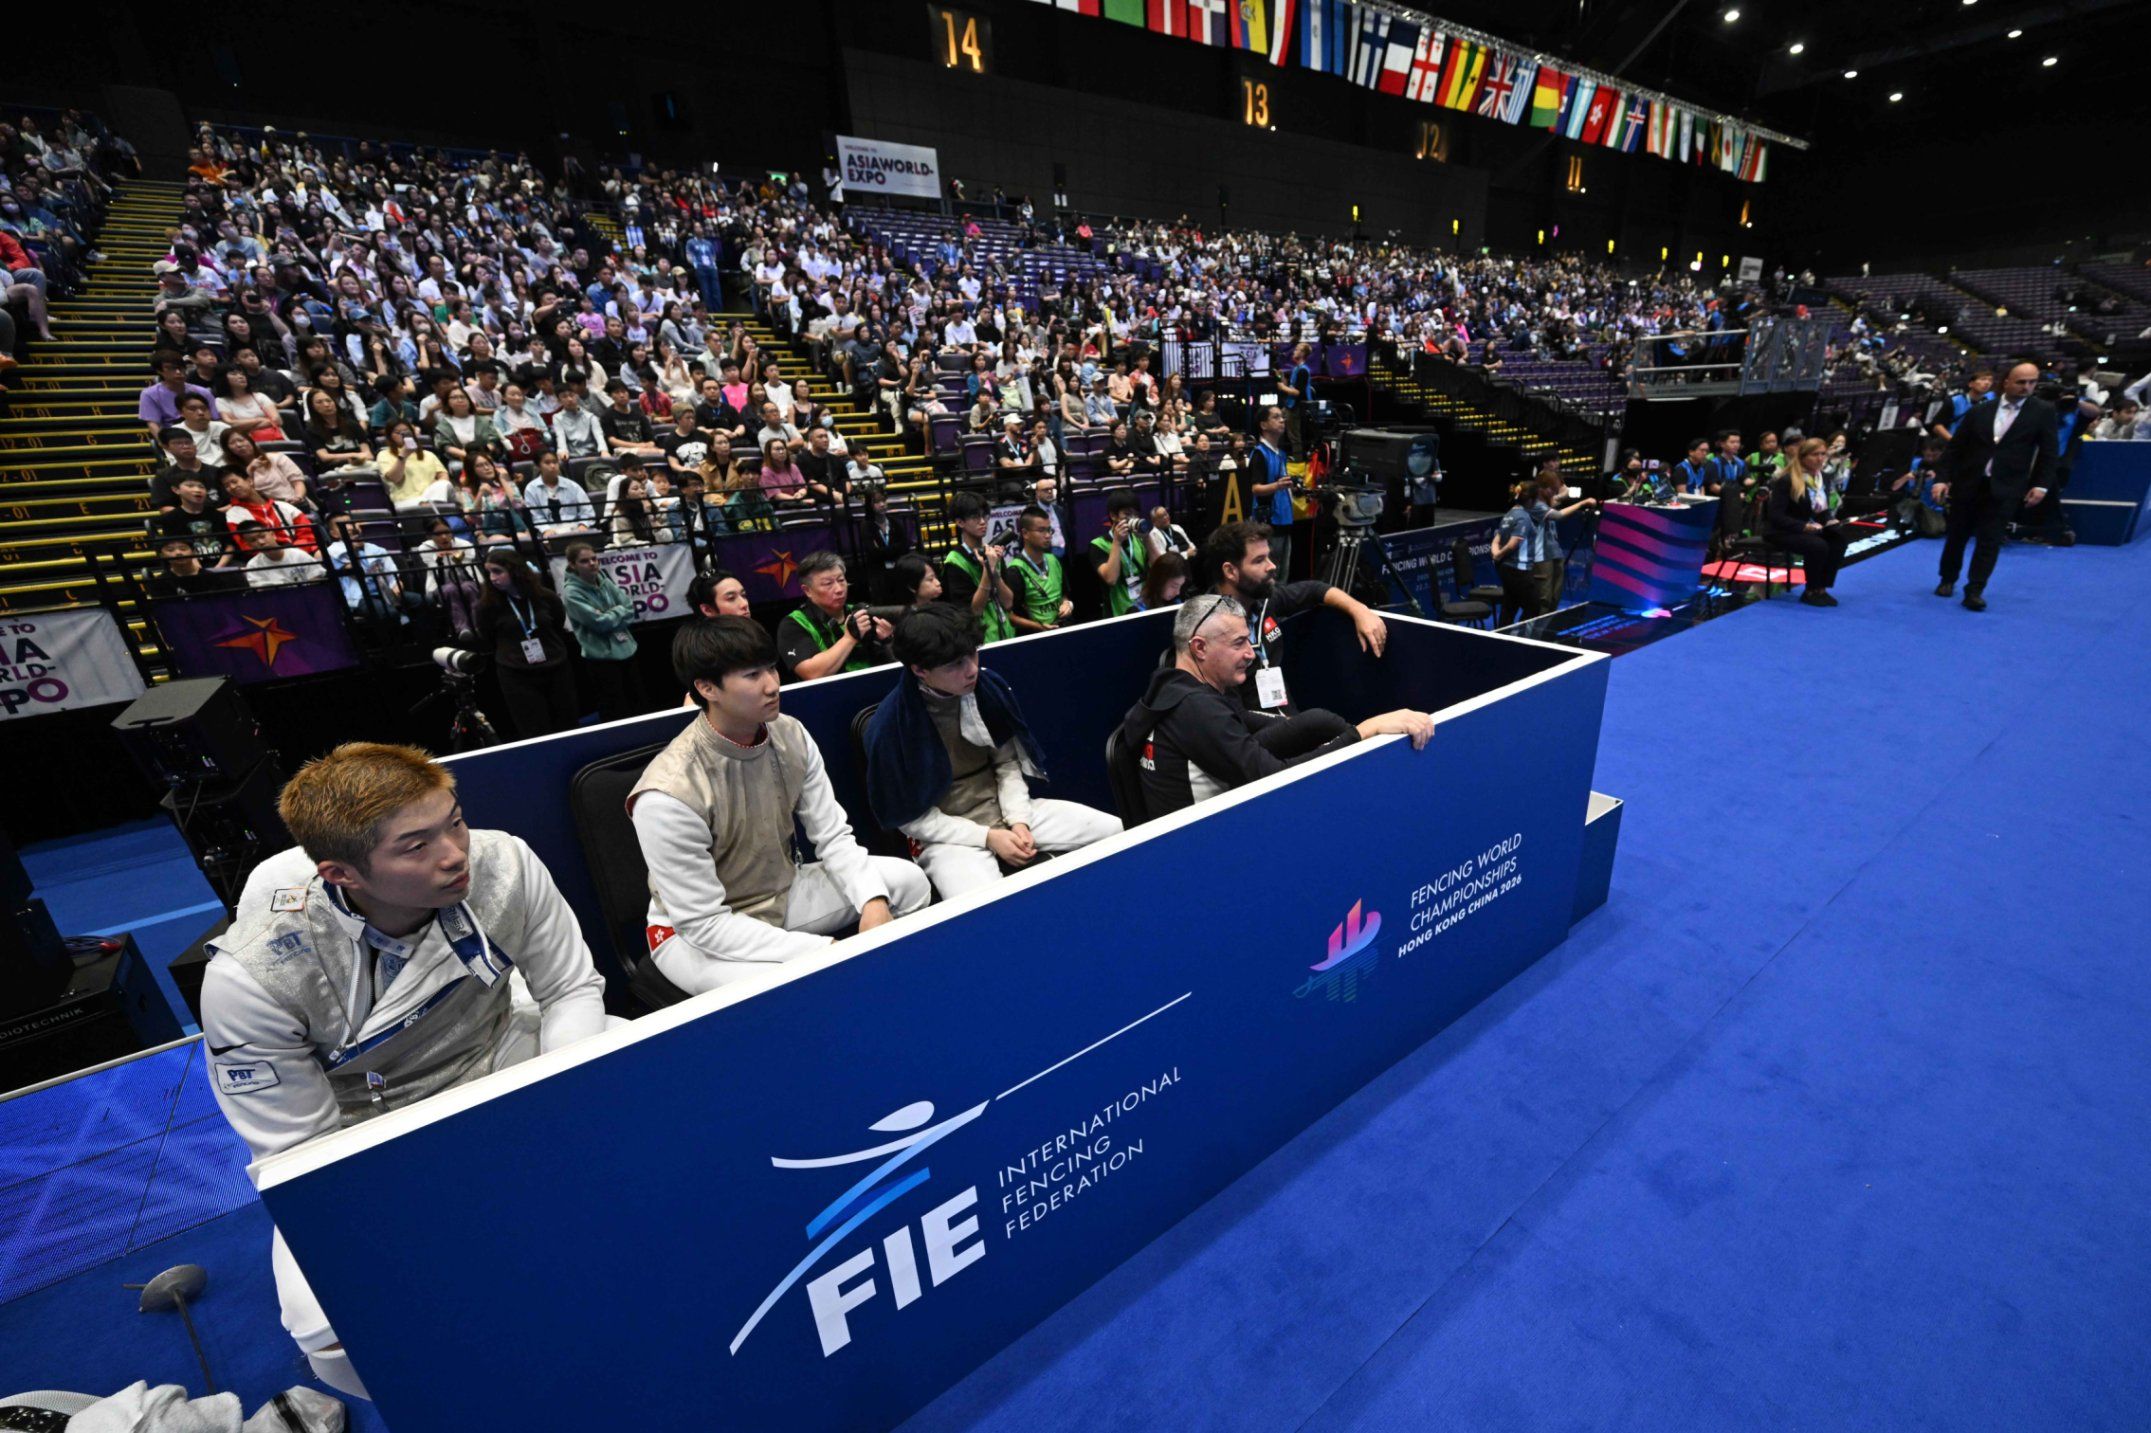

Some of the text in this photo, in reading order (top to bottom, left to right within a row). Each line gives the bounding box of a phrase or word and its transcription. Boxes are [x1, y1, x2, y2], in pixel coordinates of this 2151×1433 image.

[941, 11, 982, 71] 14
[1244, 80, 1268, 126] 13
[847, 154, 934, 176] ASIAWORLD-
[848, 168, 886, 185] EXPO
[1221, 472, 1244, 526] A
[644, 552, 657, 560] TO
[8, 623, 36, 635] TO
[1410, 856, 1517, 931] CHAMPIONSHIPS
[1411, 832, 1522, 909] FENCING WORLD
[1398, 873, 1522, 958] HONG KONG CHINA 2026
[227, 1069, 256, 1081] PBT
[998, 1066, 1182, 1188] INTERNATIONAL
[1002, 1135, 1111, 1214] FENCING
[1005, 1138, 1144, 1239] FEDERATION
[806, 1184, 986, 1358] FIE
